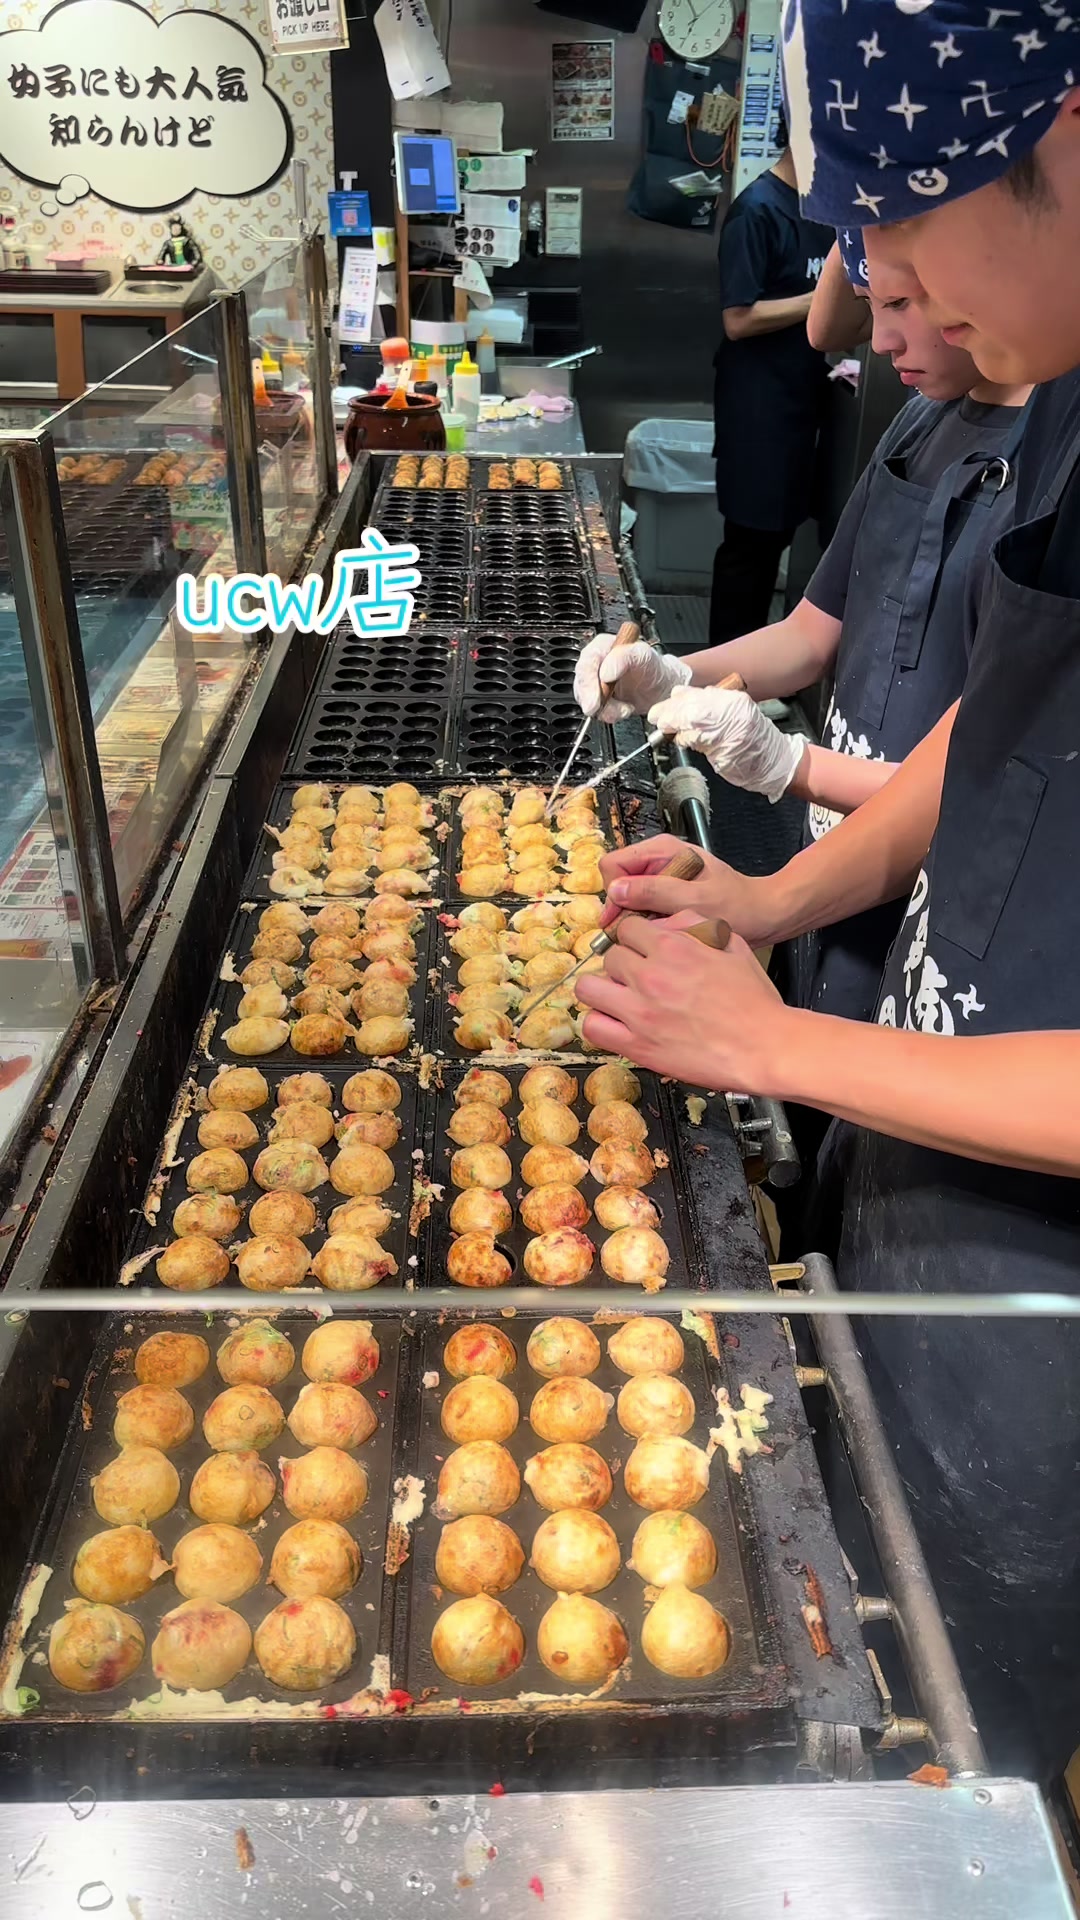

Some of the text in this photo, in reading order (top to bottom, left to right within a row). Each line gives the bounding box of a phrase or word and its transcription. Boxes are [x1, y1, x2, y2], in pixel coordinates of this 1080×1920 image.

[667, 11, 674, 22] 9
[720, 14, 726, 25] 3
[282, 20, 330, 36] PICK UP HERE
[667, 26, 676, 37] 8
[714, 28, 721, 37] 4
[691, 42, 698, 53] 6
[705, 39, 712, 50] 5
[49, 112, 215, 147] 知らんけど
